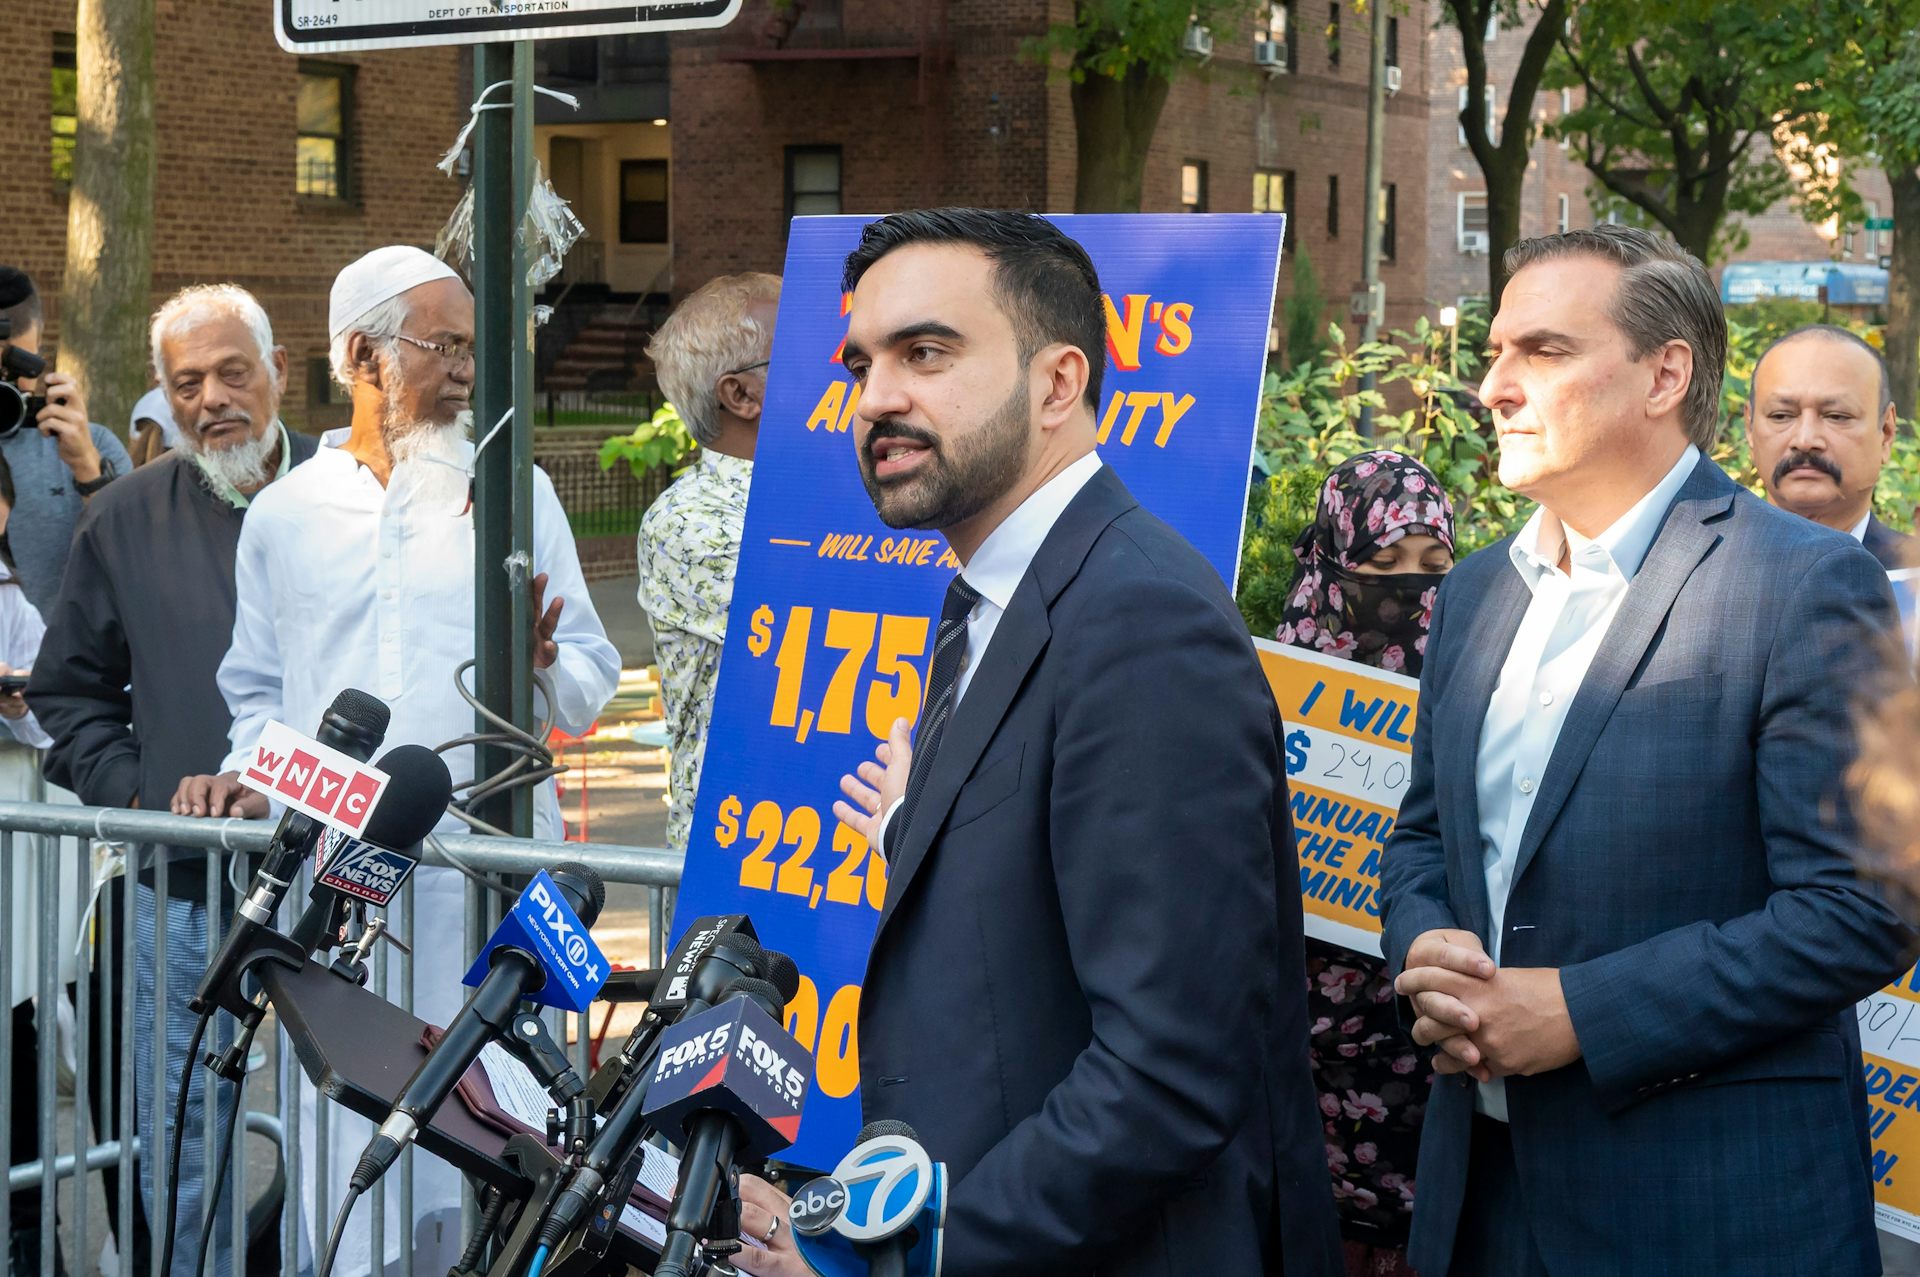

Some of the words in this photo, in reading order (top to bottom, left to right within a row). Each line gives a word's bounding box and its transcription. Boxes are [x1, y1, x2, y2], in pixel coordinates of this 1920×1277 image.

[297, 14, 338, 27] SR-2649
[428, 8, 455, 19] DEPT
[459, 7, 472, 17] OF
[476, 1, 569, 16] TRANSPORTATION
[817, 532, 869, 562] WILL
[874, 538, 940, 567] SAVE
[935, 545, 961, 569] A
[747, 604, 935, 744] $1,75
[1298, 680, 1326, 718] I
[1338, 688, 1415, 748] WIL
[1285, 729, 1312, 776] $
[1323, 743, 1412, 791] 24,0
[257, 746, 367, 814] WNYC
[1288, 789, 1395, 844] NNUAL
[358, 856, 402, 880] FOX
[1294, 828, 1353, 869] THE
[325, 877, 389, 901] channel
[338, 867, 395, 893] NEWS
[677, 930, 711, 973] NEWS
[654, 1066, 683, 1084] NEW
[689, 1047, 726, 1069] YORK
[736, 1051, 762, 1077] NEW
[767, 1076, 800, 1110] YORK
[788, 1190, 845, 1219] abc
